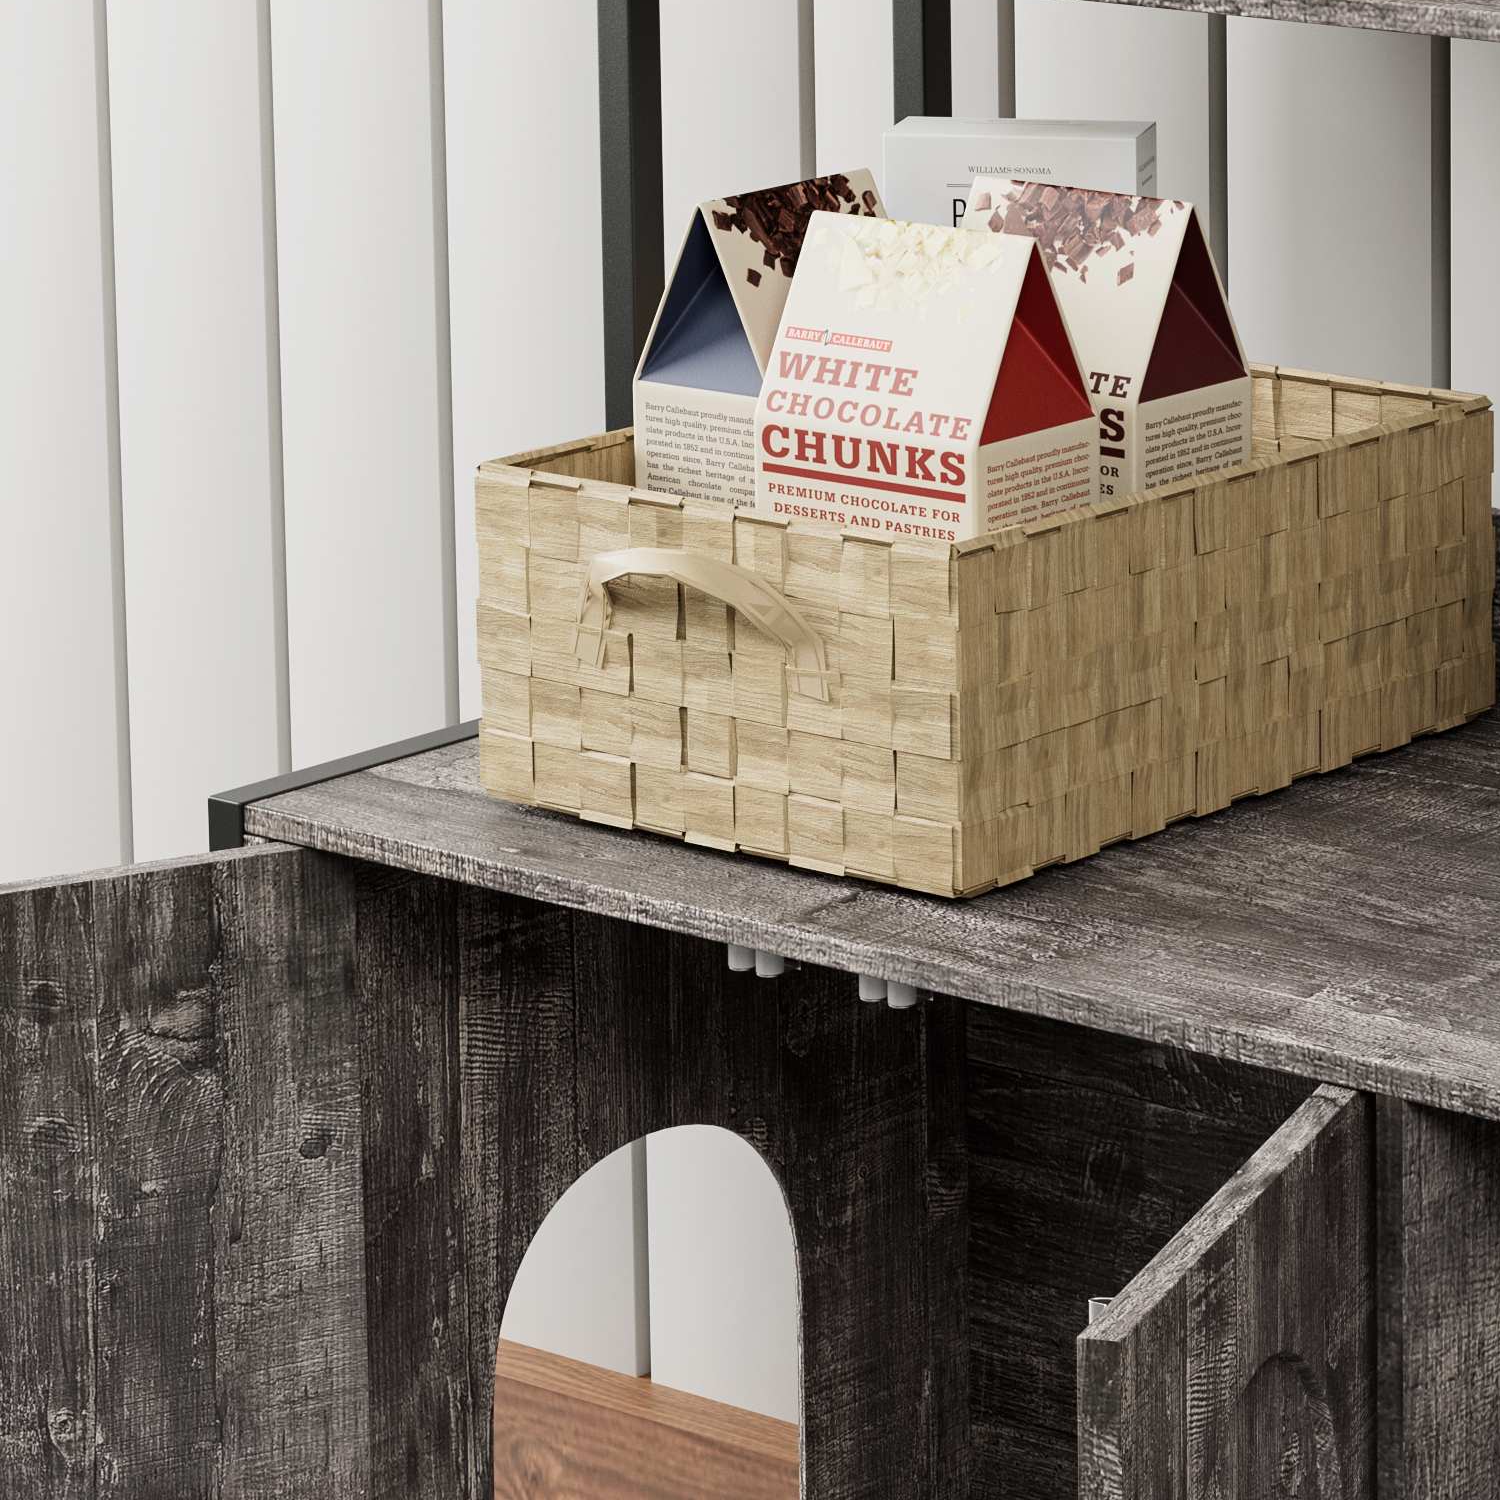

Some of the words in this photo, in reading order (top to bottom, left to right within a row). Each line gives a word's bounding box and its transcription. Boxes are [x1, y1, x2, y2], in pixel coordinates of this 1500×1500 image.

[787, 328, 822, 341] BARRY
[832, 334, 891, 351] CALLEBAUT
[779, 350, 919, 397] WHITE
[646, 402, 664, 412] Barry
[666, 405, 699, 416] Callebaut
[701, 412, 727, 422] proudly
[646, 415, 663, 423] tures
[665, 417, 680, 426] high
[682, 421, 708, 431] quality,
[710, 426, 741, 434] premium
[766, 389, 972, 441] CHOCOLATE
[1145, 434, 1161, 442] tures
[1162, 428, 1175, 438] high
[1177, 424, 1198, 435] quality,
[1200, 417, 1226, 429] premium
[1227, 412, 1242, 420] choc-
[1146, 421, 1162, 430] Barry
[1163, 413, 1191, 425] Callebaut
[1192, 407, 1215, 420] proudly
[1216, 401, 1242, 412] manufac-
[646, 426, 663, 434] olate
[665, 430, 695, 439] products
[706, 435, 717, 443] the
[719, 437, 739, 446] U.S.A.
[646, 439, 673, 448] porated
[683, 443, 698, 451] 1852
[723, 451, 754, 460] continuo
[1145, 446, 1160, 454] olate
[1162, 438, 1188, 451] products
[1207, 428, 1224, 437] U.S.A.
[1226, 424, 1242, 433] Incor-
[647, 451, 679, 460] operation
[683, 455, 702, 465] since,
[706, 458, 725, 469] Barry
[729, 462, 754, 472] Calleba
[761, 424, 966, 486] CHUNKS
[987, 464, 1004, 473] Barry
[1006, 456, 1035, 468] Callebaut
[1037, 449, 1060, 462] proudly
[1062, 442, 1089, 453] manufac-
[1145, 453, 1168, 467] porated
[1177, 448, 1190, 457] 1852
[1191, 444, 1202, 454] and
[1211, 436, 1242, 448] continuous
[1145, 466, 1174, 478] operation
[1177, 461, 1193, 469] since,
[1196, 455, 1212, 464] Barry
[1215, 447, 1242, 459] Callebaut
[647, 461, 659, 469] has
[678, 466, 701, 475] richest
[706, 470, 735, 482] heritage
[647, 473, 680, 484] American
[688, 480, 721, 490] chocolate
[987, 477, 1003, 486] tures
[1005, 472, 1019, 481] high
[1021, 467, 1043, 478] quality,
[1045, 459, 1072, 472] premium
[1074, 454, 1090, 462] choc-
[988, 490, 1003, 498] olate
[1005, 482, 1032, 495] products
[1053, 470, 1070, 480] U.S.A.
[1073, 466, 1090, 475] Incor-
[1100, 466, 1120, 478] OR
[648, 484, 667, 493] Barry
[669, 488, 702, 499] Callebaut
[768, 482, 836, 504] PREMIUM
[840, 494, 927, 518] CHOCOLATE
[932, 509, 960, 523] FOR
[988, 498, 1012, 512] porated
[1021, 491, 1034, 501] 1852
[1036, 488, 1048, 497] and
[1057, 478, 1090, 491] continuous
[988, 510, 1018, 523] operation
[1021, 505, 1038, 514] since,
[1041, 499, 1058, 508] Barry
[1061, 490, 1090, 502] Callebaut
[774, 502, 846, 523] DESSERTS
[850, 515, 881, 529] AND
[885, 520, 956, 541] PASTRIES
